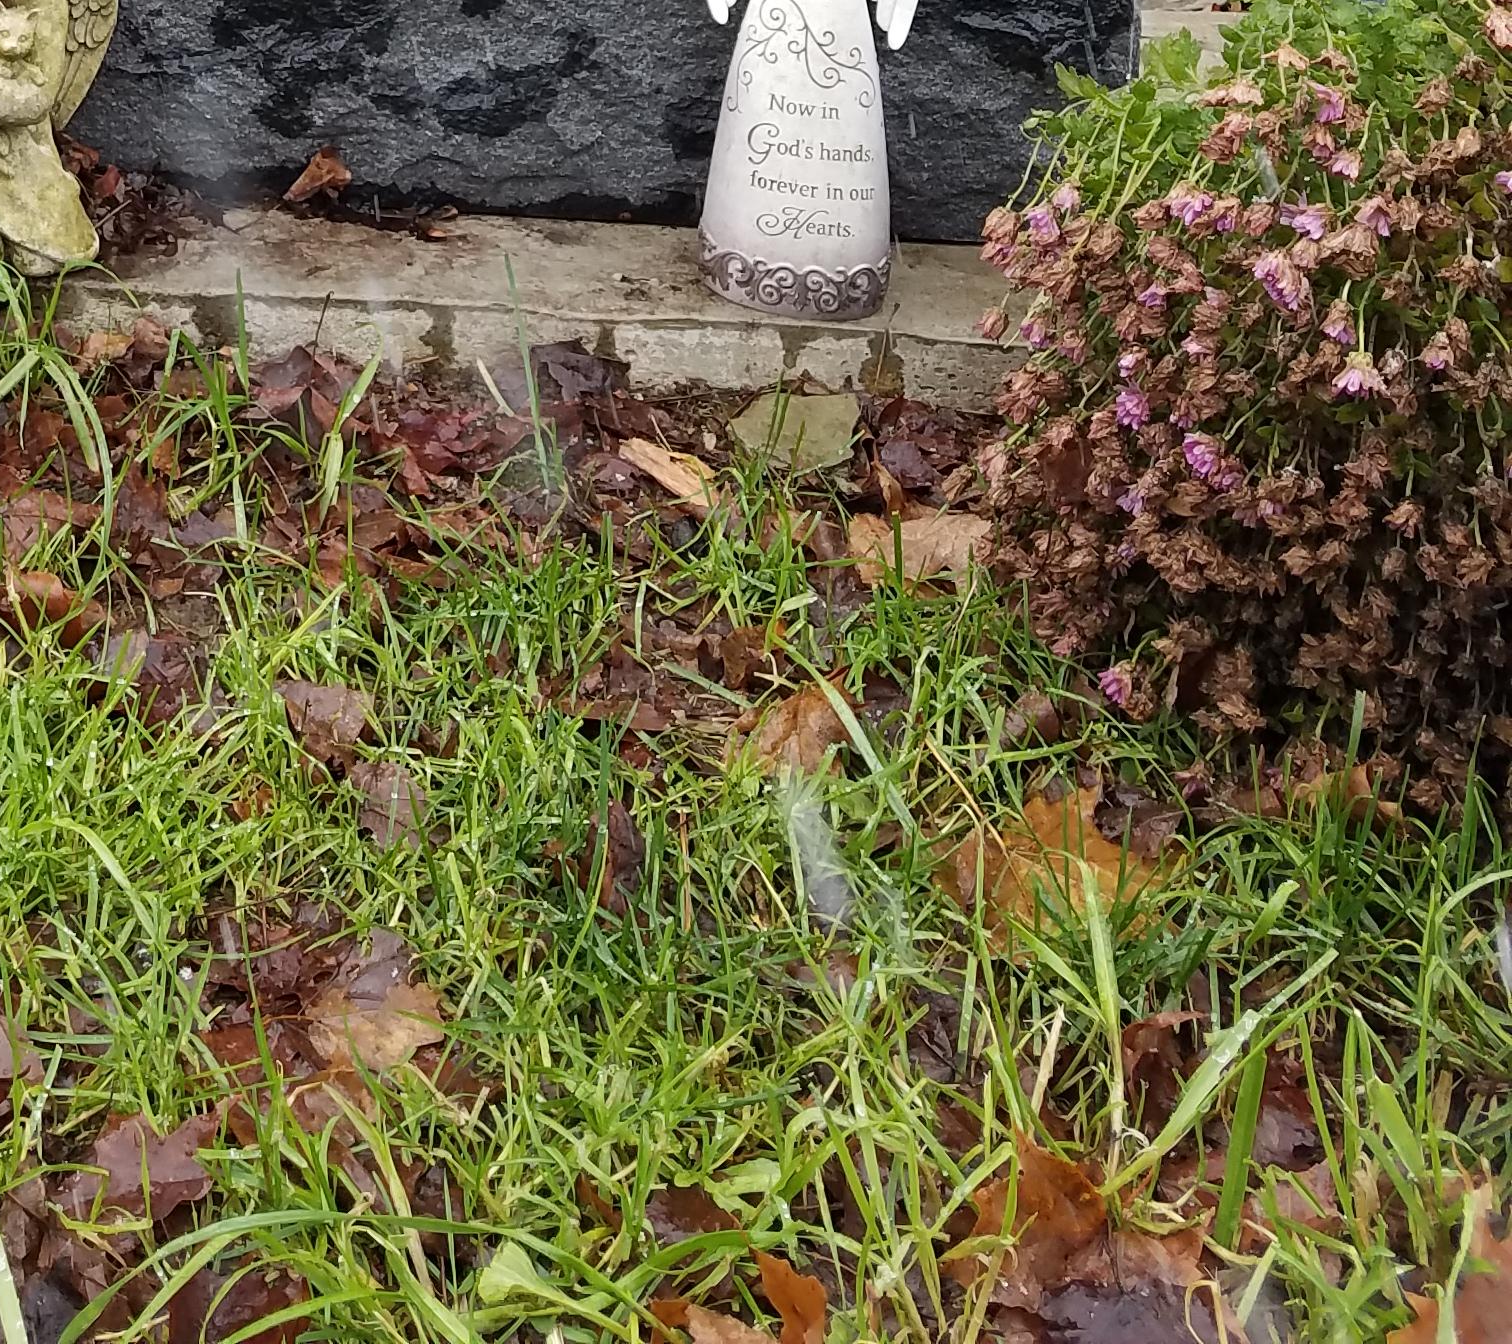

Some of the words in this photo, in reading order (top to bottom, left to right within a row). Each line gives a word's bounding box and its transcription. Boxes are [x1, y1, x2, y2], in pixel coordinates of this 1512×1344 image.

[768, 93, 816, 118] Now
[821, 102, 840, 120] in
[748, 123, 814, 164] God's
[750, 170, 818, 199] forever
[826, 183, 843, 201] in
[849, 187, 875, 201] our
